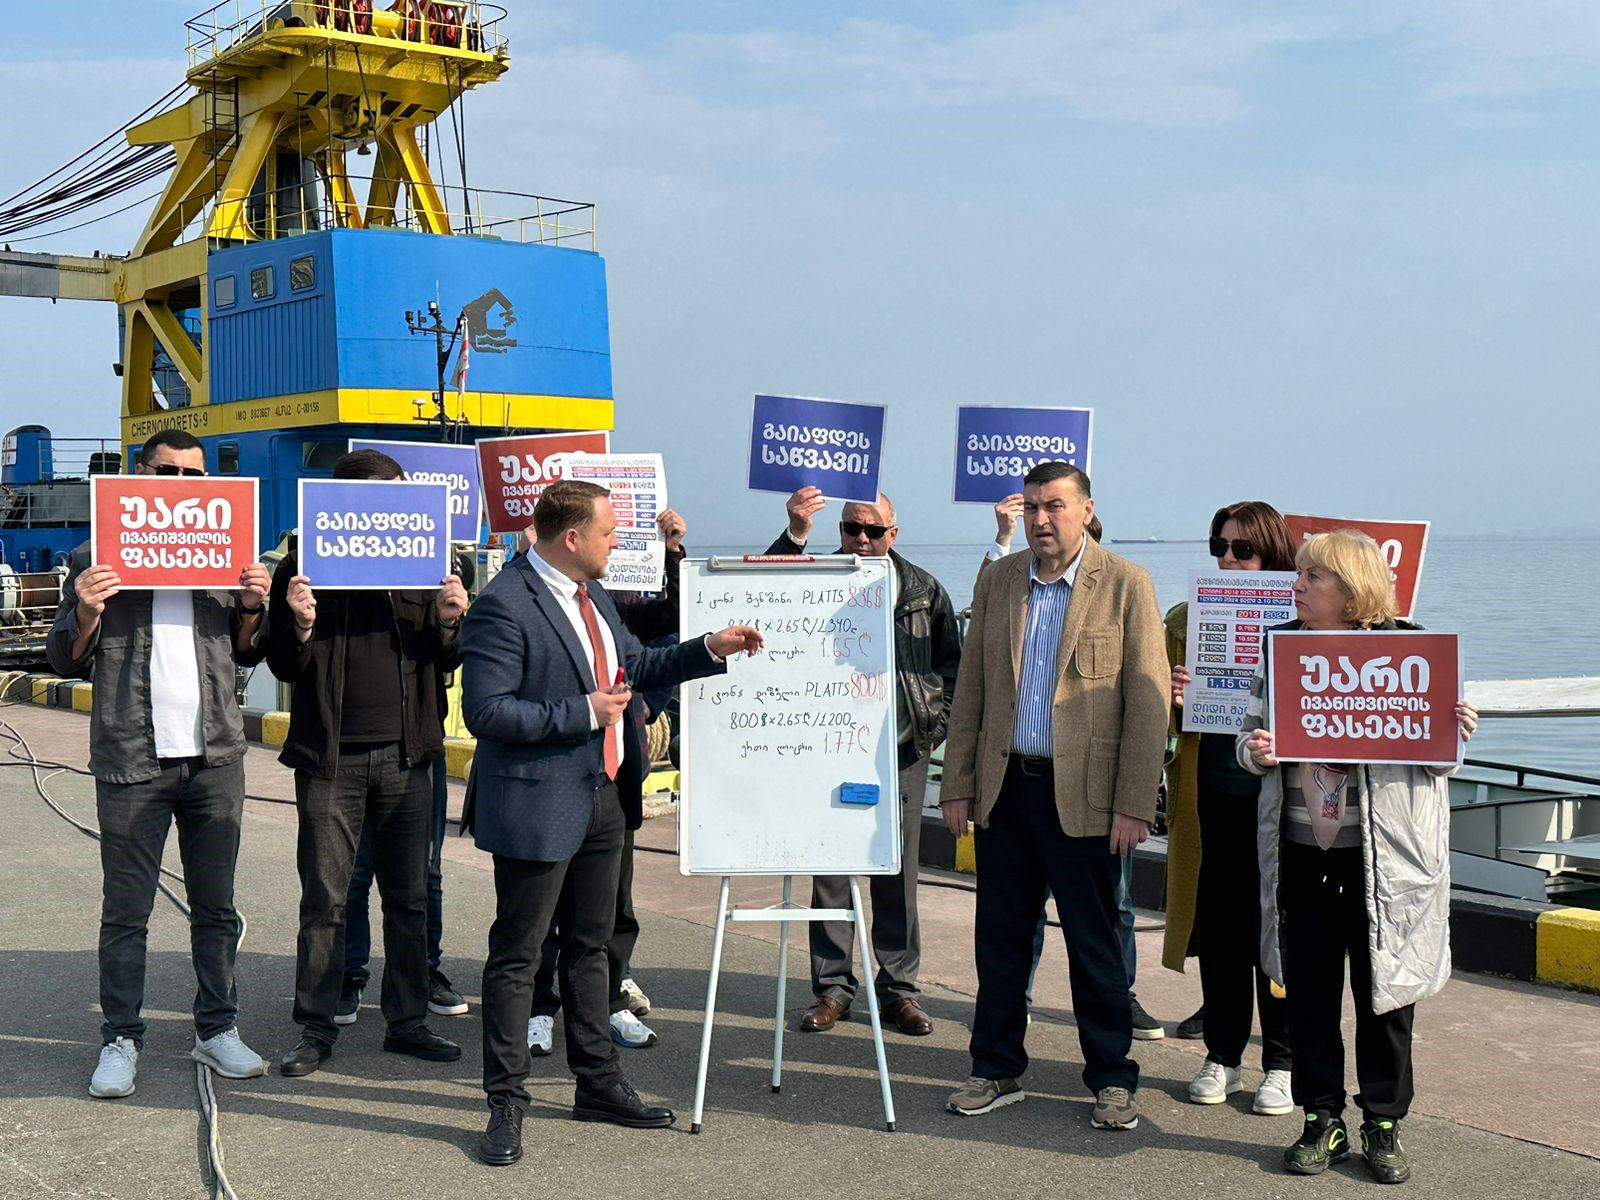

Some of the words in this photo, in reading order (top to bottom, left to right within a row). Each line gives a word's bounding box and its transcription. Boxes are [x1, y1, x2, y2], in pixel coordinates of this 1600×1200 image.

[131, 412, 208, 437] CHERNOMORETS-9
[762, 423, 870, 450] გაიაფდეს
[967, 433, 1076, 454] გაიაფდეს
[761, 444, 870, 475] საწვავი!
[119, 496, 232, 530] უარი
[315, 511, 436, 532] გაიაფდეს
[120, 531, 232, 545] ივანიშვილის
[316, 535, 436, 558] საწვავი!
[120, 547, 232, 569] ფასებს!
[609, 564, 657, 574] მადლობა
[709, 592, 734, 609] ტონა
[746, 590, 792, 608] ბენზინი
[802, 589, 844, 604] PLATTS
[1237, 610, 1260, 618] 2012
[1300, 655, 1430, 693] უარი
[711, 684, 744, 705] ტონა
[804, 682, 850, 698] PLATTS
[1300, 695, 1430, 711] ივანიშვილის
[1192, 703, 1226, 714] დიდი
[1192, 713, 1232, 725] ბატონ
[1301, 713, 1430, 740] ფასებს!
[741, 741, 768, 758] ერთი
[776, 742, 813, 756] ლიტრი
